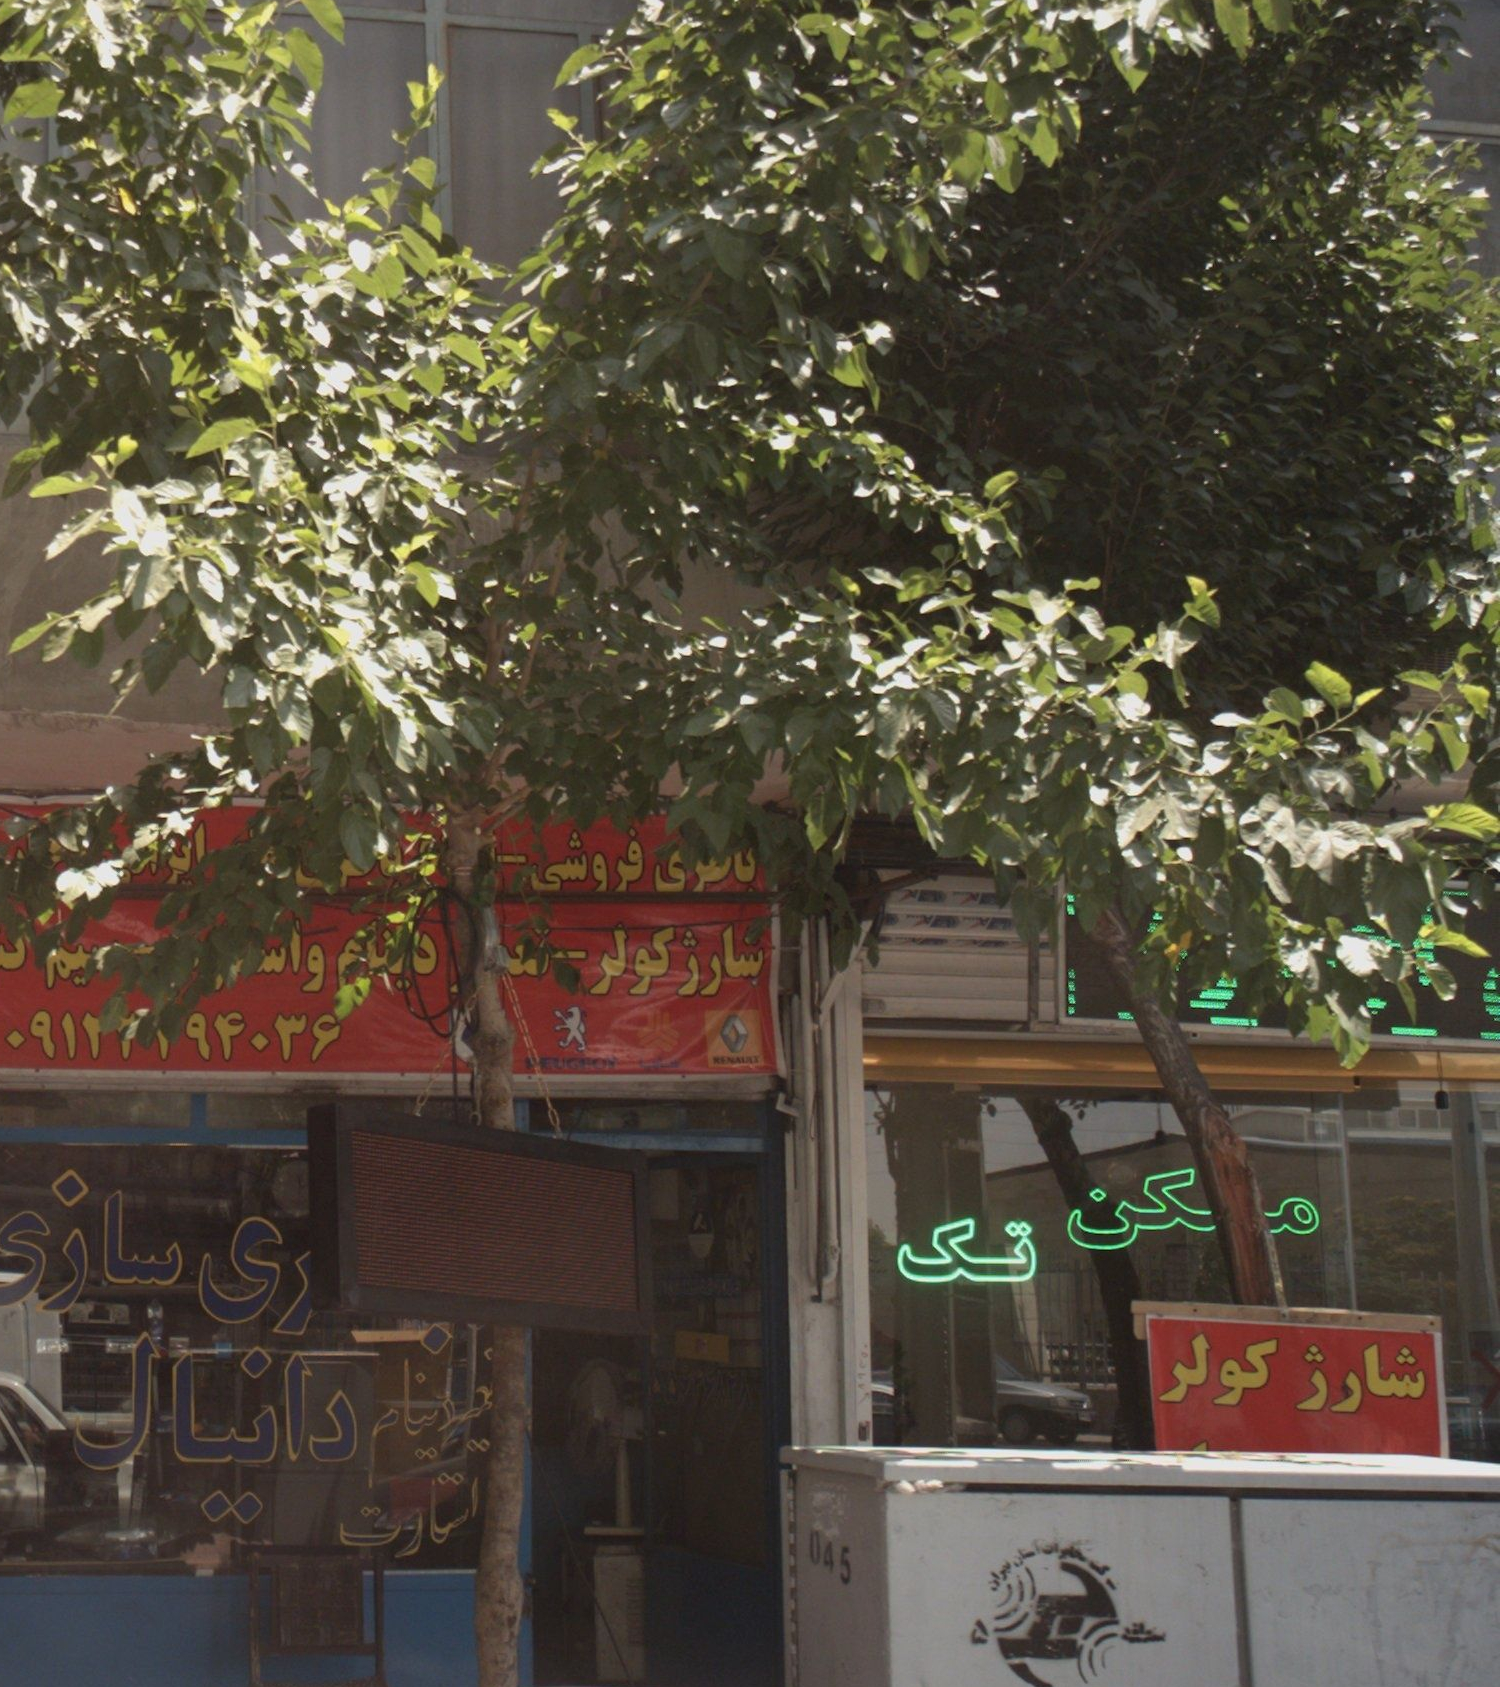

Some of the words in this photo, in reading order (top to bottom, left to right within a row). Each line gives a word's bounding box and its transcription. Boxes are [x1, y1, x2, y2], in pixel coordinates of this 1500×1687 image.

[530, 826, 645, 894] فروشی
[589, 924, 677, 997] کولر
[712, 1055, 761, 1066] RENAULT
[1067, 1167, 1320, 1250] مکن
[896, 1217, 1038, 1283] تک
[1159, 1333, 1279, 1406] کولر
[1296, 1344, 1427, 1414] شارژ
[73, 1330, 360, 1525] دانیال
[339, 1470, 480, 1559] استارت
